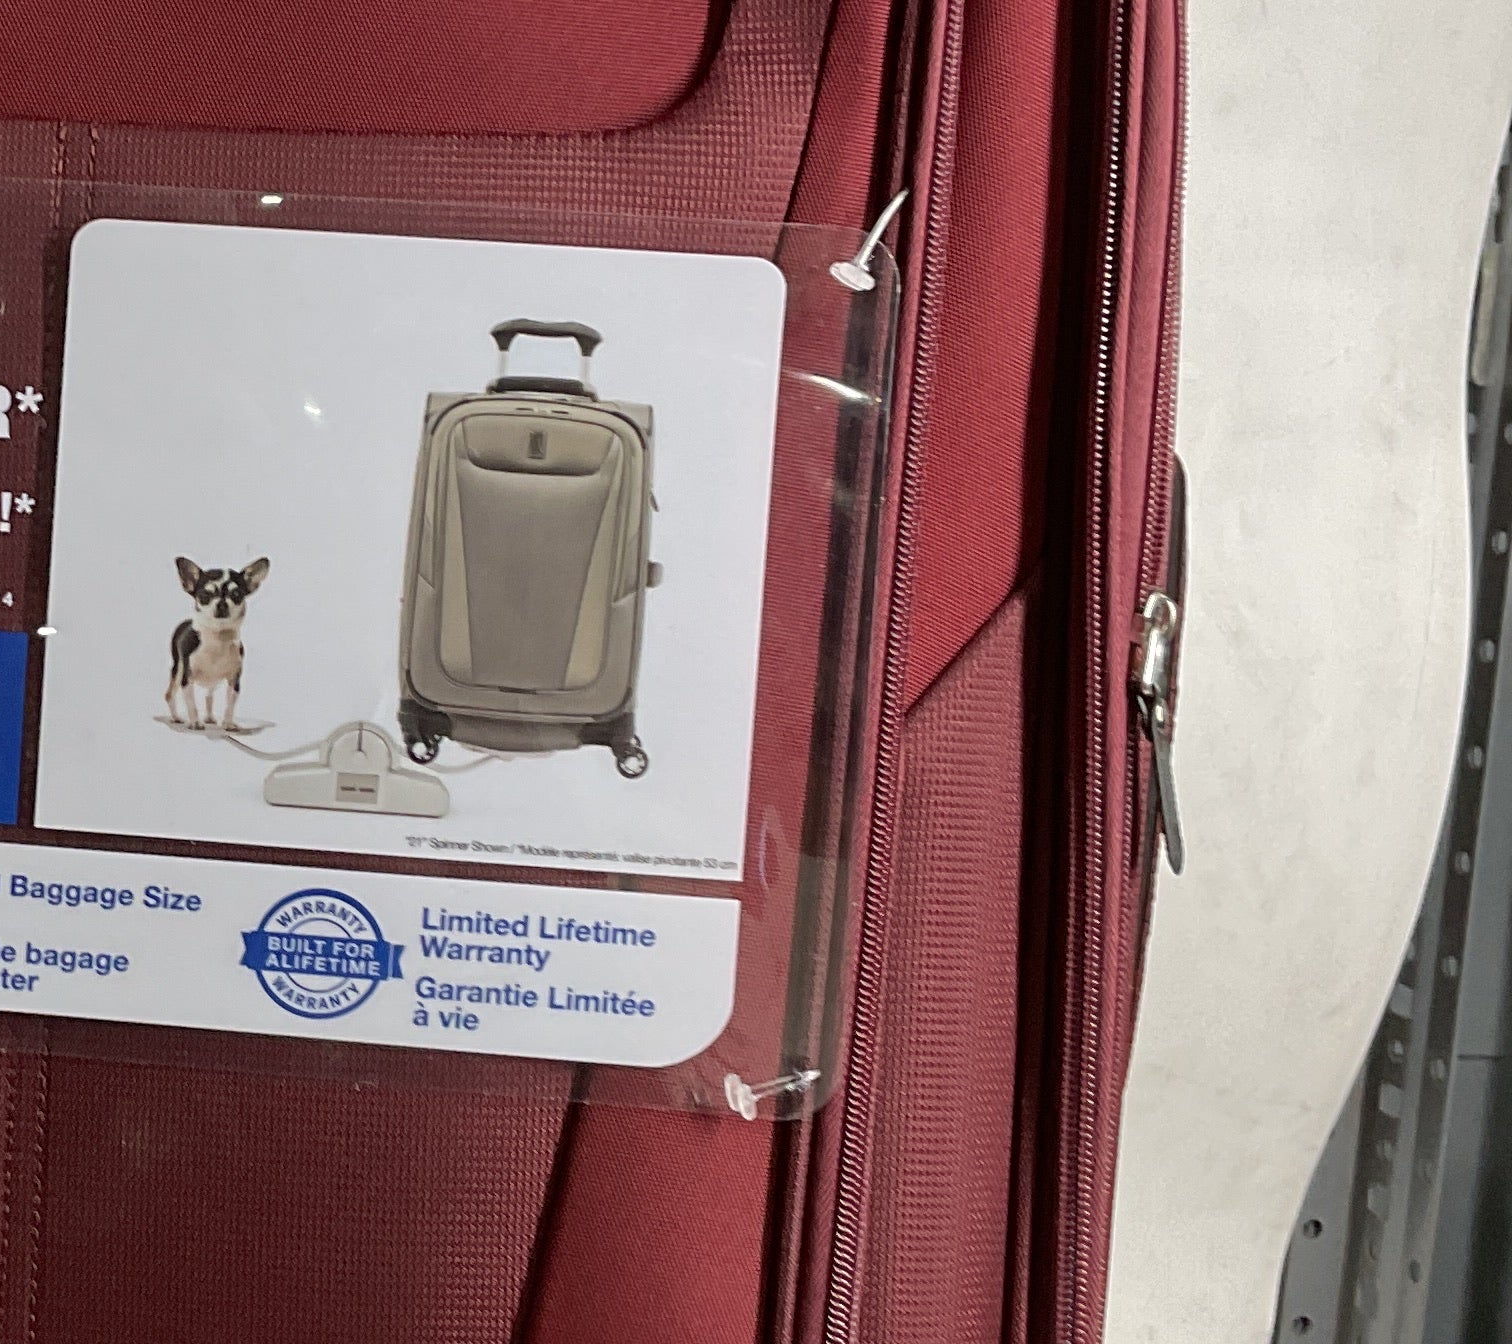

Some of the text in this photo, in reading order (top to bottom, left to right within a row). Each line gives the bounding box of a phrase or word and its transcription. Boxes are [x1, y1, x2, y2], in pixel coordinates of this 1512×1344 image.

[2, 591, 14, 607] 4
[10, 875, 134, 909] Baggage
[142, 885, 202, 912] Size
[276, 900, 368, 934] WARRANTY
[420, 907, 657, 948] Limited Lifetime
[25, 942, 130, 976] bagage
[267, 935, 376, 959] BUILT FOR
[419, 934, 551, 973] Warranty
[272, 976, 361, 1010] WARRANTY
[414, 975, 656, 1018] Garantie Limitée
[412, 1001, 480, 1032] à vie
